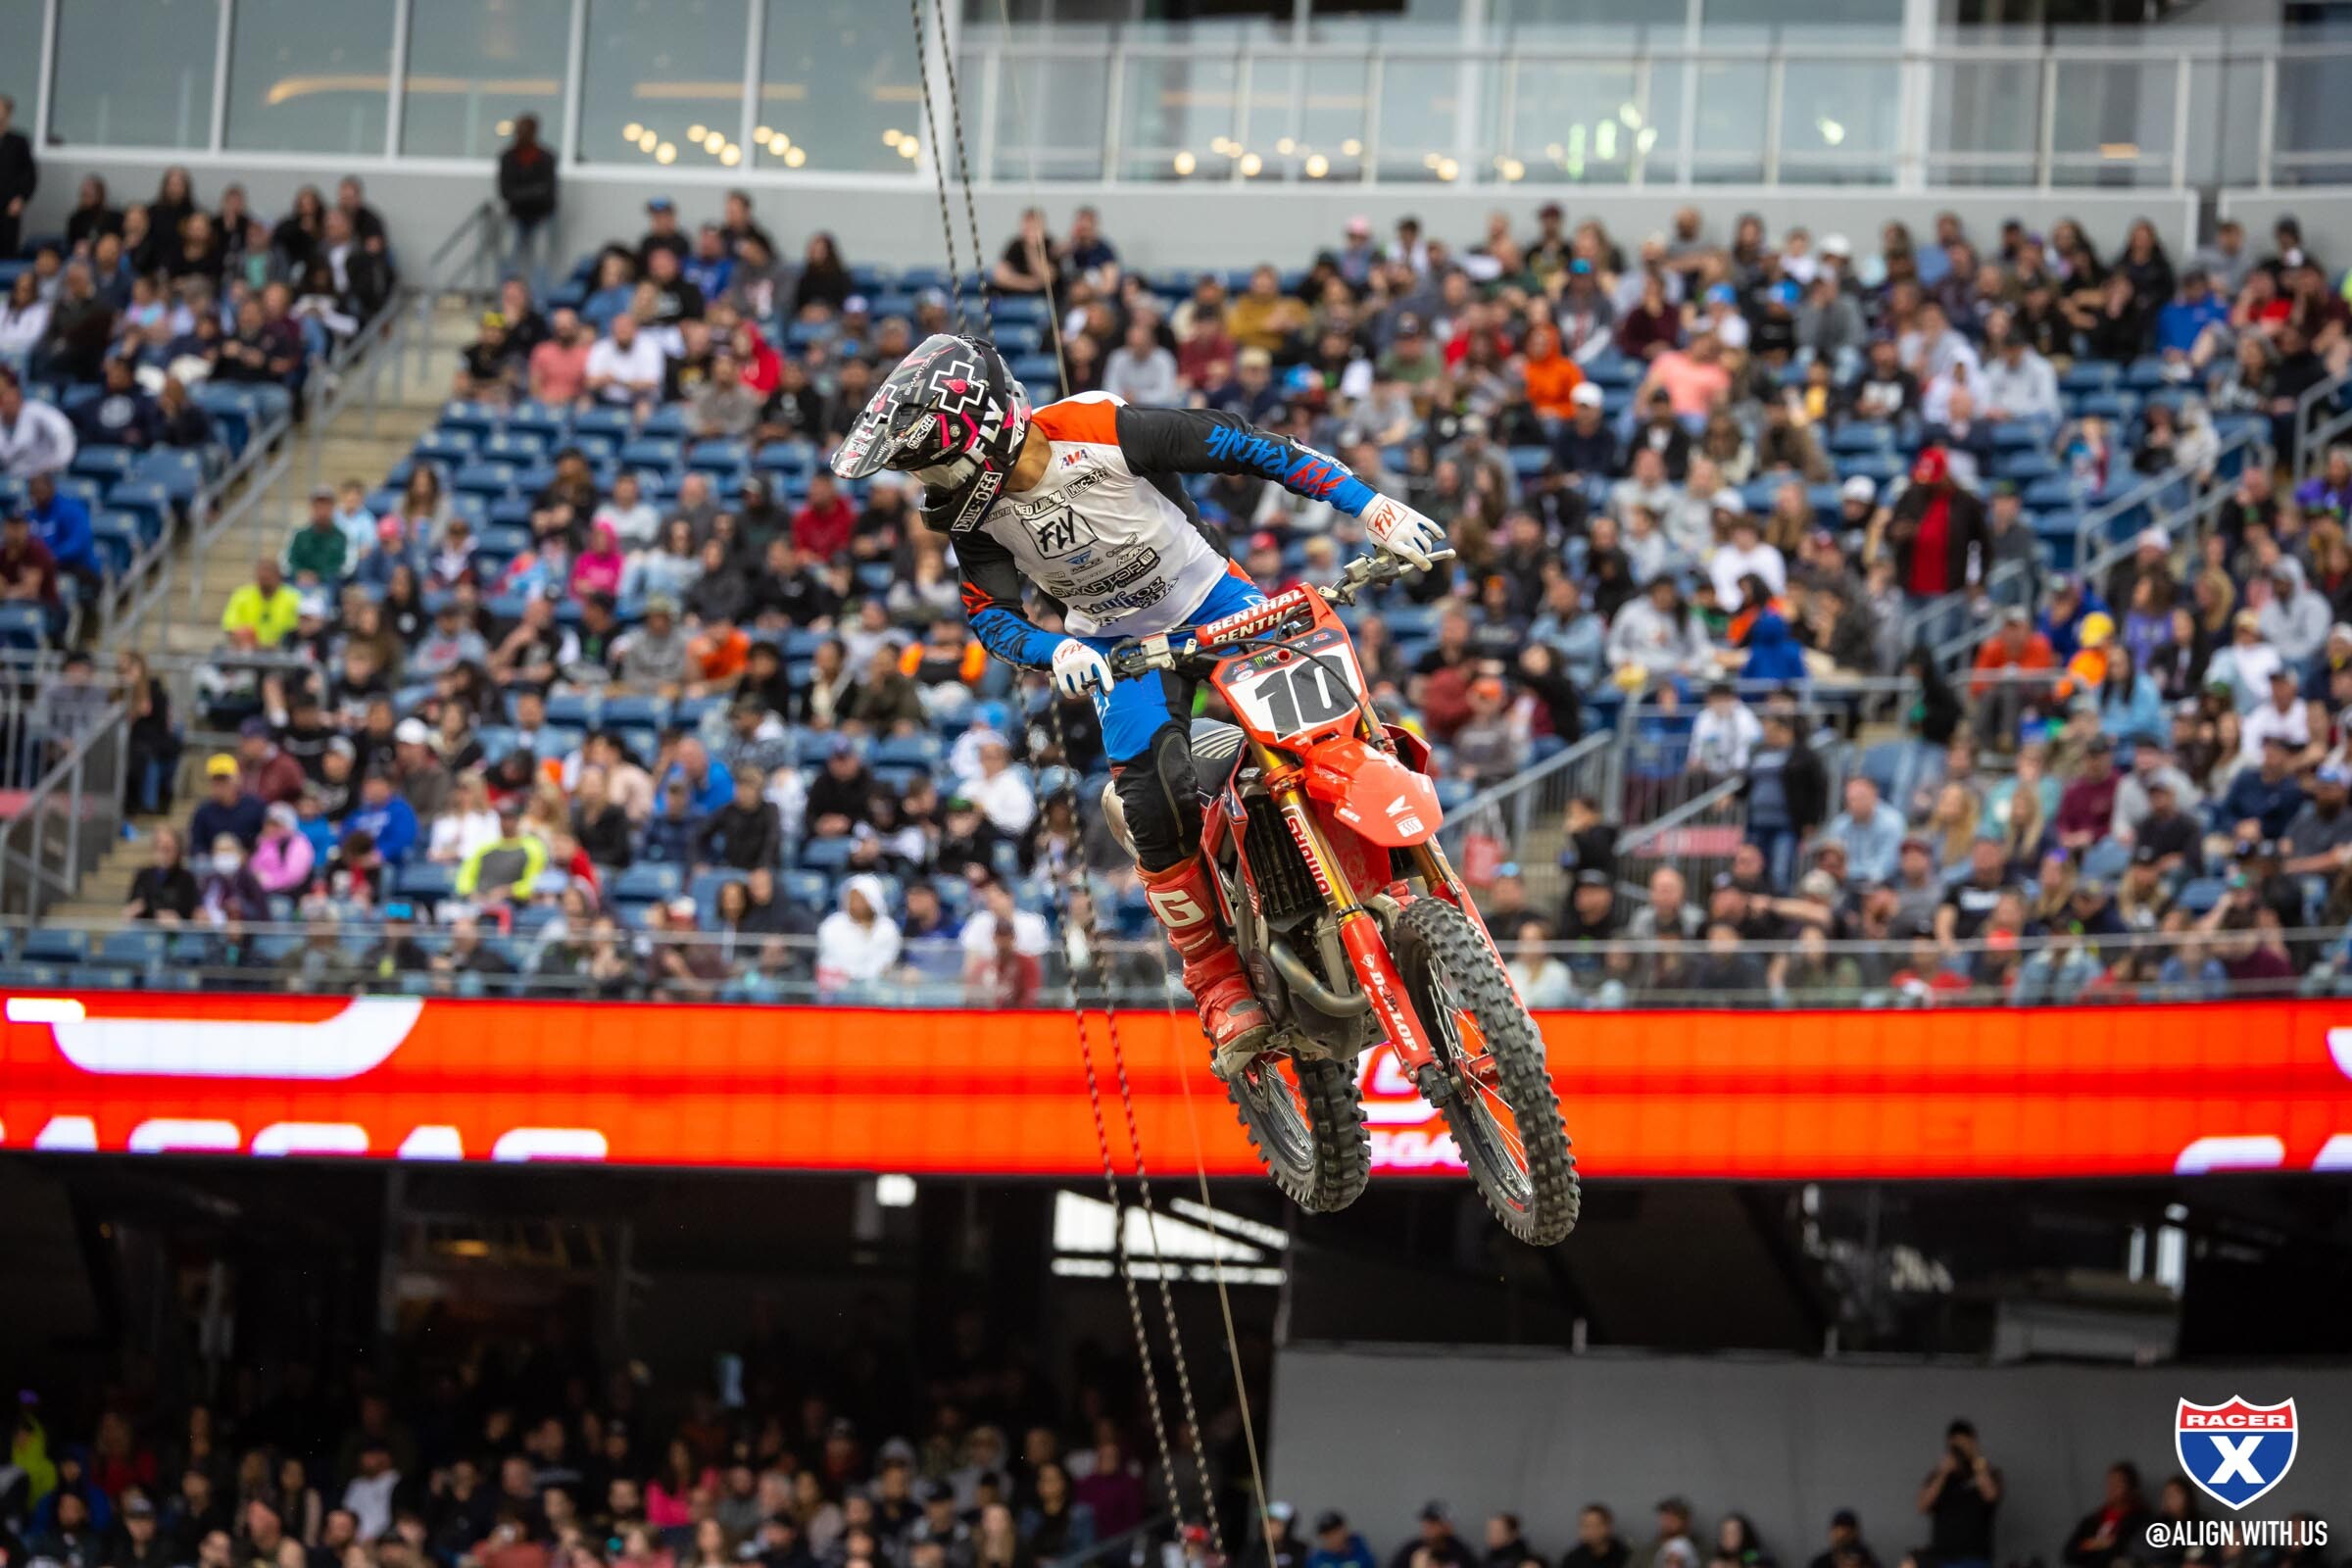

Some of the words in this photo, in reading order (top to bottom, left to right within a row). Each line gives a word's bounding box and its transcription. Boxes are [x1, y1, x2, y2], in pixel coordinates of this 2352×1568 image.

[964, 396, 1004, 465] FLY
[1059, 449, 1089, 469] AMA
[1036, 509, 1076, 553] FLY
[1374, 503, 1396, 535] FLY
[1206, 589, 1306, 636] RENTHAL
[1254, 654, 1356, 737] 10
[1287, 815, 1333, 896] SHOWA
[1149, 889, 1205, 928] G
